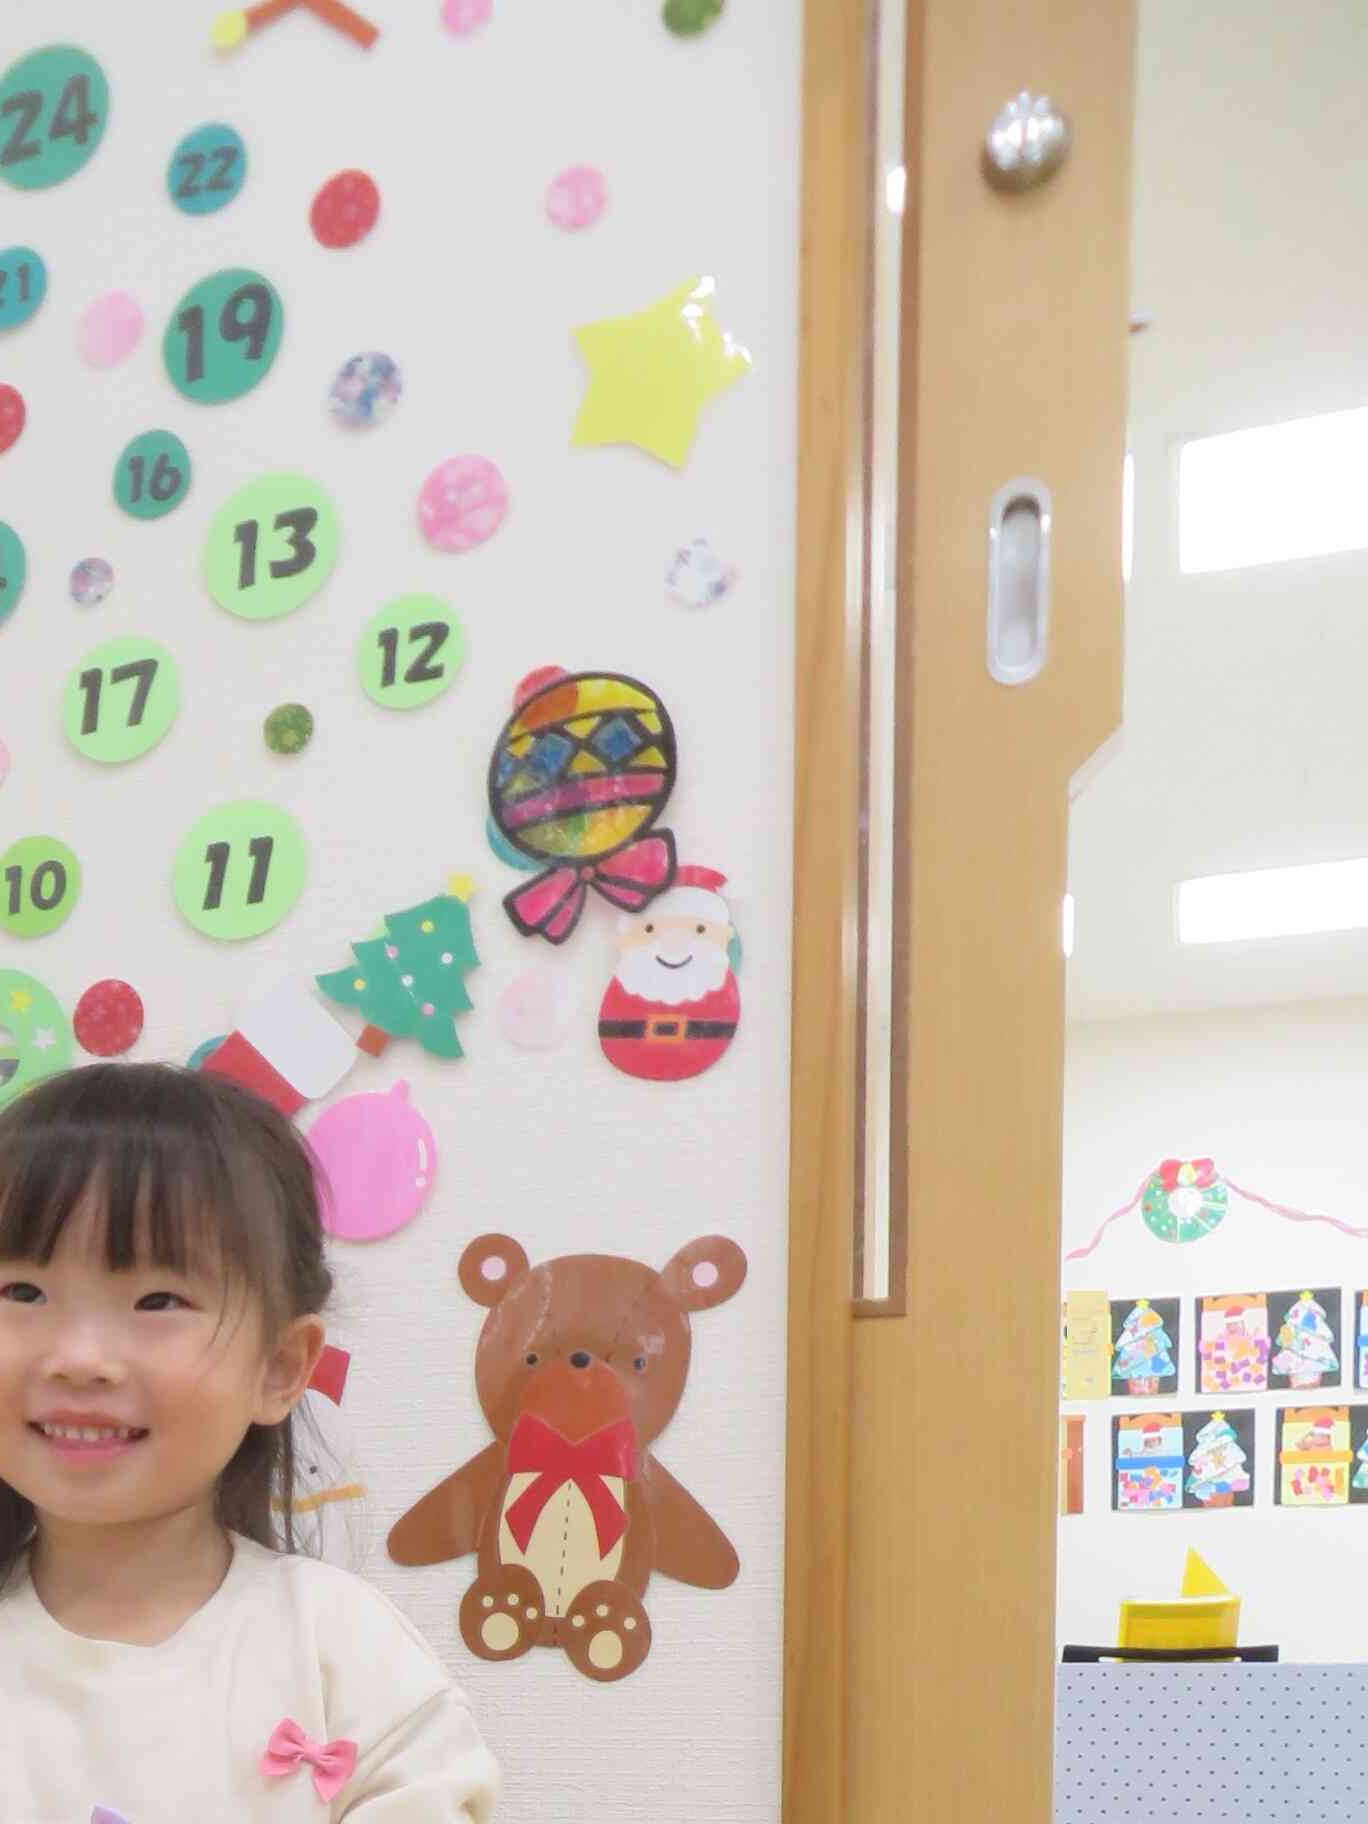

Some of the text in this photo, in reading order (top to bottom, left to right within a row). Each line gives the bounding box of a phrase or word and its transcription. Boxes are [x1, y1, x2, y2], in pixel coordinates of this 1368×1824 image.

[0, 75, 98, 166] 24
[176, 146, 239, 199] 22
[178, 283, 273, 384] 19
[128, 454, 182, 503] 16
[234, 507, 318, 589] 13
[378, 622, 450, 688] 12
[80, 659, 159, 735] 17
[5, 859, 68, 916] 10
[203, 836, 274, 910] 11
